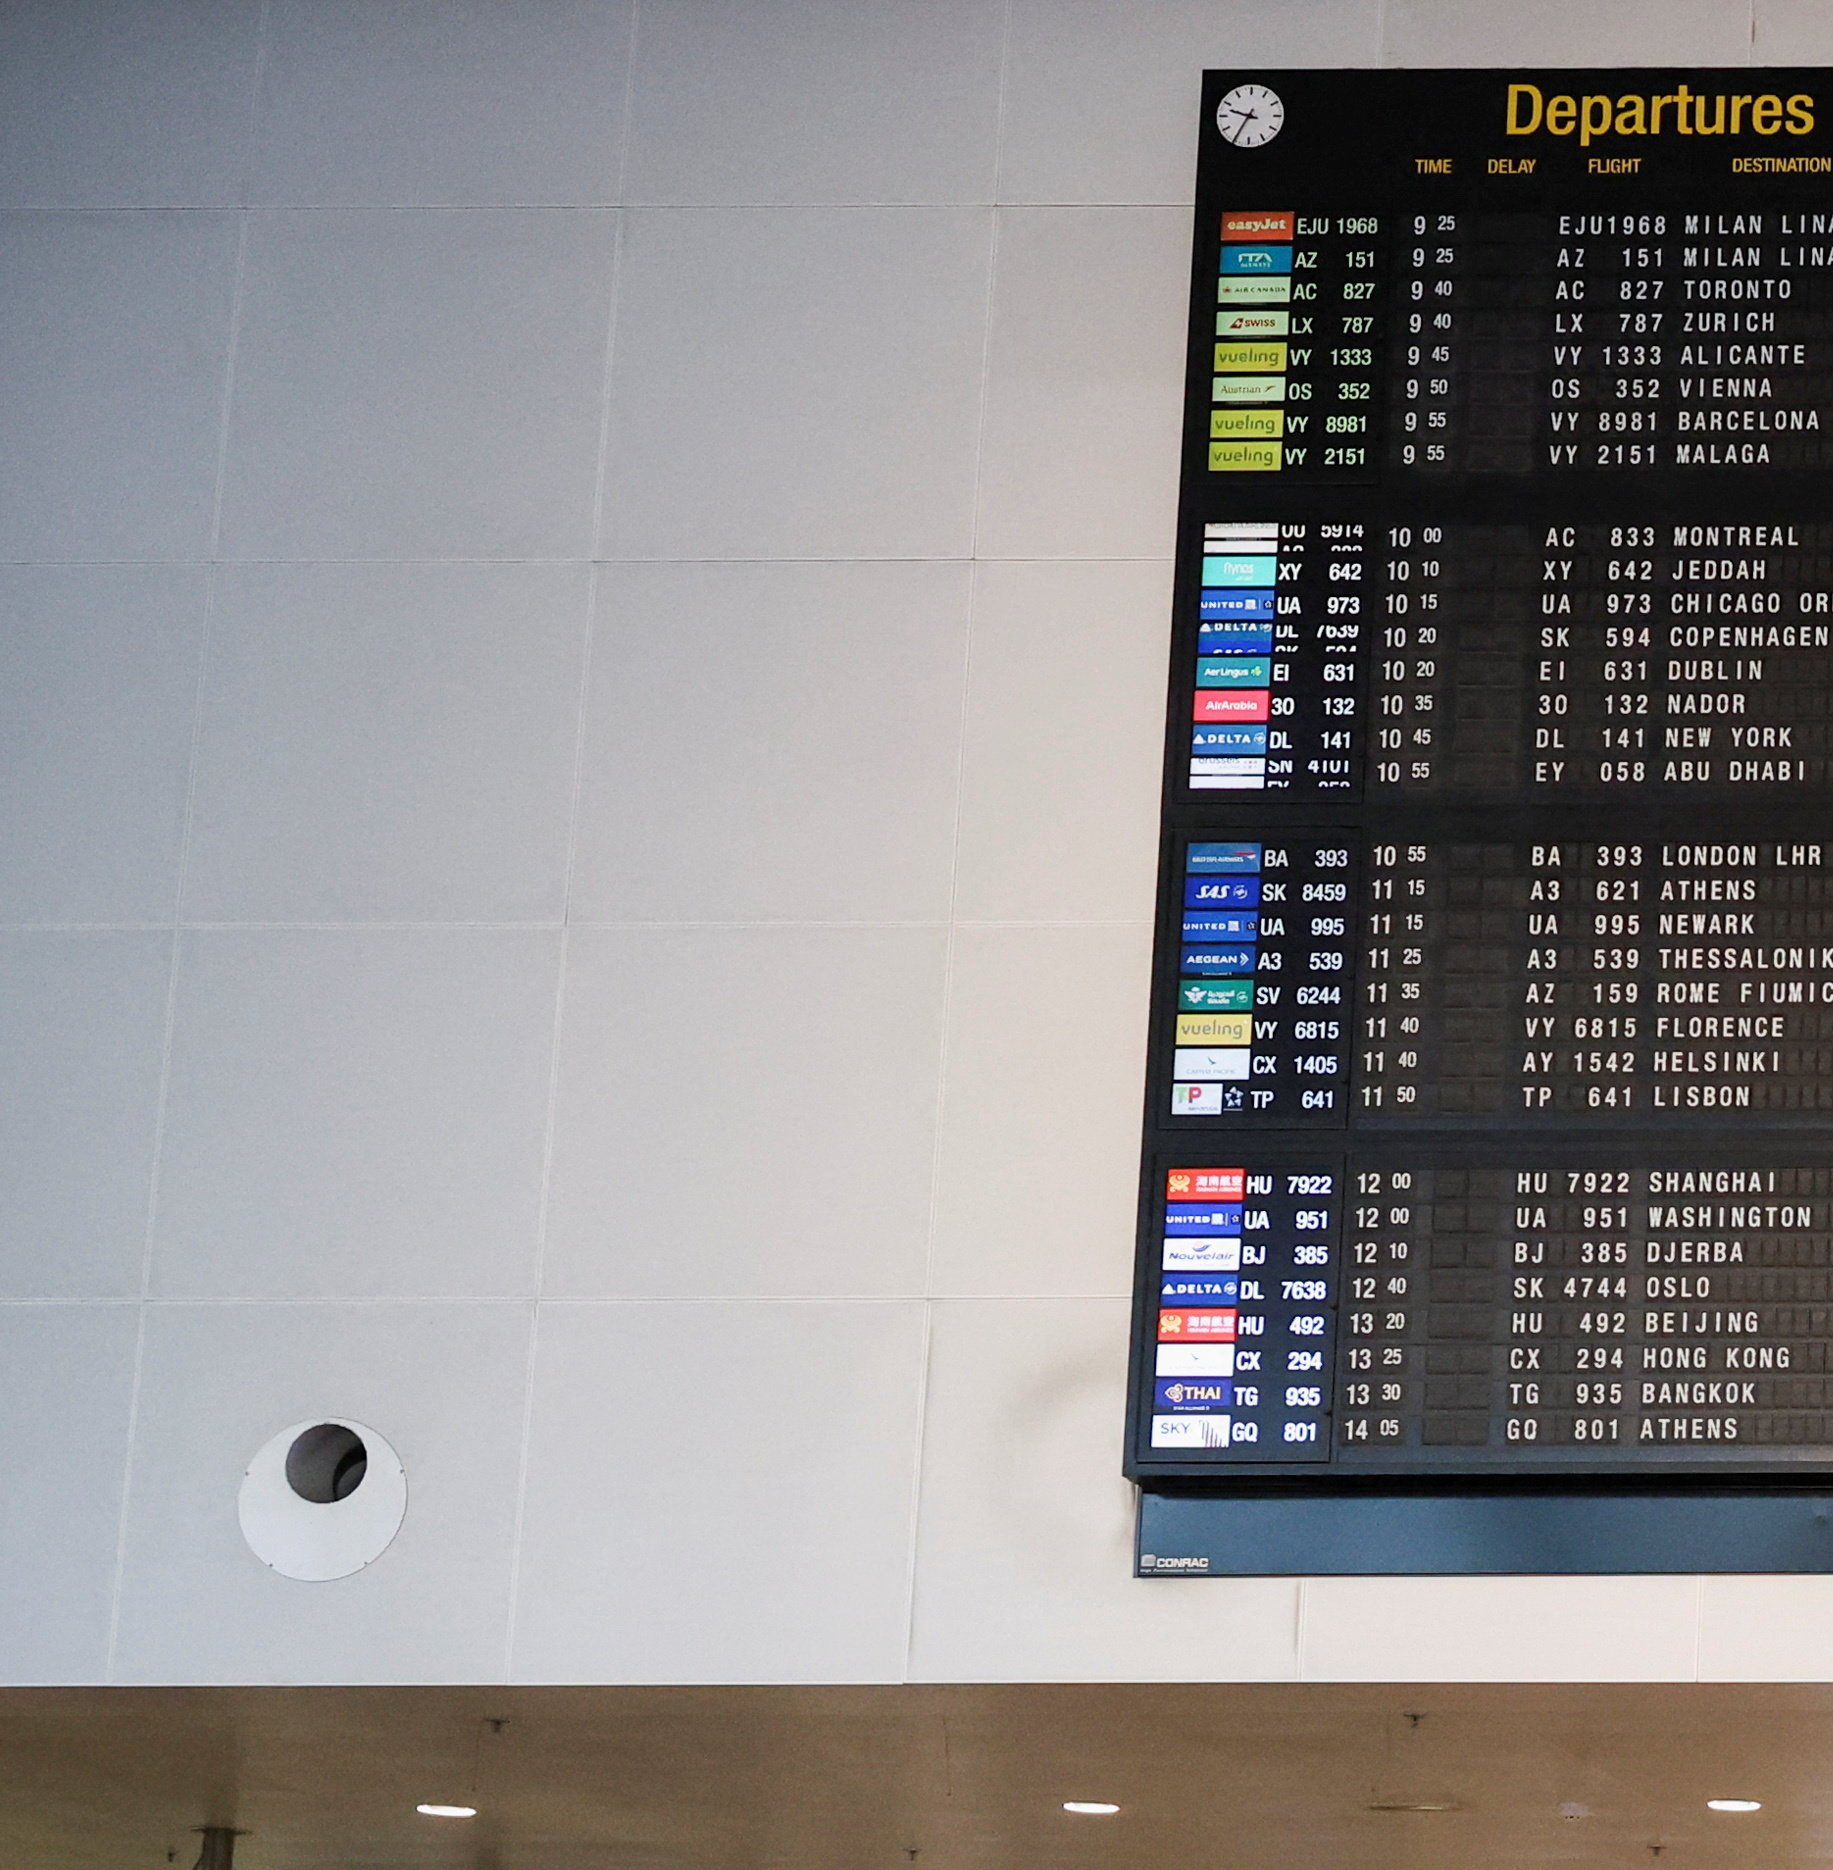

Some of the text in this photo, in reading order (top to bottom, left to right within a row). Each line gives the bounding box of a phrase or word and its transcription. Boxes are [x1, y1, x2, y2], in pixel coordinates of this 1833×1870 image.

[1506, 84, 1814, 147] Departures
[1415, 158, 1452, 174] TIME
[1487, 158, 1536, 174] DELAY
[1588, 158, 1642, 174] FLIGHT
[1732, 157, 1832, 173] DESTINATION
[1685, 215, 1762, 234] MILAN
[1555, 280, 1584, 300] AC
[1620, 280, 1664, 300] 827
[1683, 279, 1791, 300] TORONTO
[1243, 318, 1276, 328] SWISS
[1219, 348, 1372, 366] vueling VY 1333
[1550, 412, 1579, 431] VY
[1598, 411, 1656, 432] 8981
[1678, 410, 1819, 431] BARCELONA
[1542, 594, 1571, 614] UA
[1607, 593, 1651, 614] 973
[1671, 592, 1780, 614] CHICAGO
[1207, 731, 1351, 750] DELTA DL 141
[1536, 728, 1565, 749] DL
[1602, 728, 1644, 748] 141
[1665, 727, 1712, 748] NEW
[1731, 726, 1792, 748] YORK
[1195, 883, 1347, 902] SAS SK 8459
[1182, 922, 1226, 932] UNITED
[1186, 954, 1237, 965] AEGEAN
[1526, 948, 1557, 970] A3
[1593, 948, 1639, 970] 539
[1246, 1175, 1333, 1195] HU 7922
[1517, 1172, 1548, 1194] HU
[1567, 1172, 1630, 1194] 7922
[1648, 1171, 1775, 1193] SHANGHAI
[1185, 1385, 1321, 1407] THAI TG 935
[1509, 1383, 1539, 1405] TG
[1576, 1383, 1622, 1405] 935
[1642, 1382, 1755, 1404] BANGKOK
[1160, 1422, 1191, 1434] SKY
[1156, 1557, 1209, 1568] CONRAC
